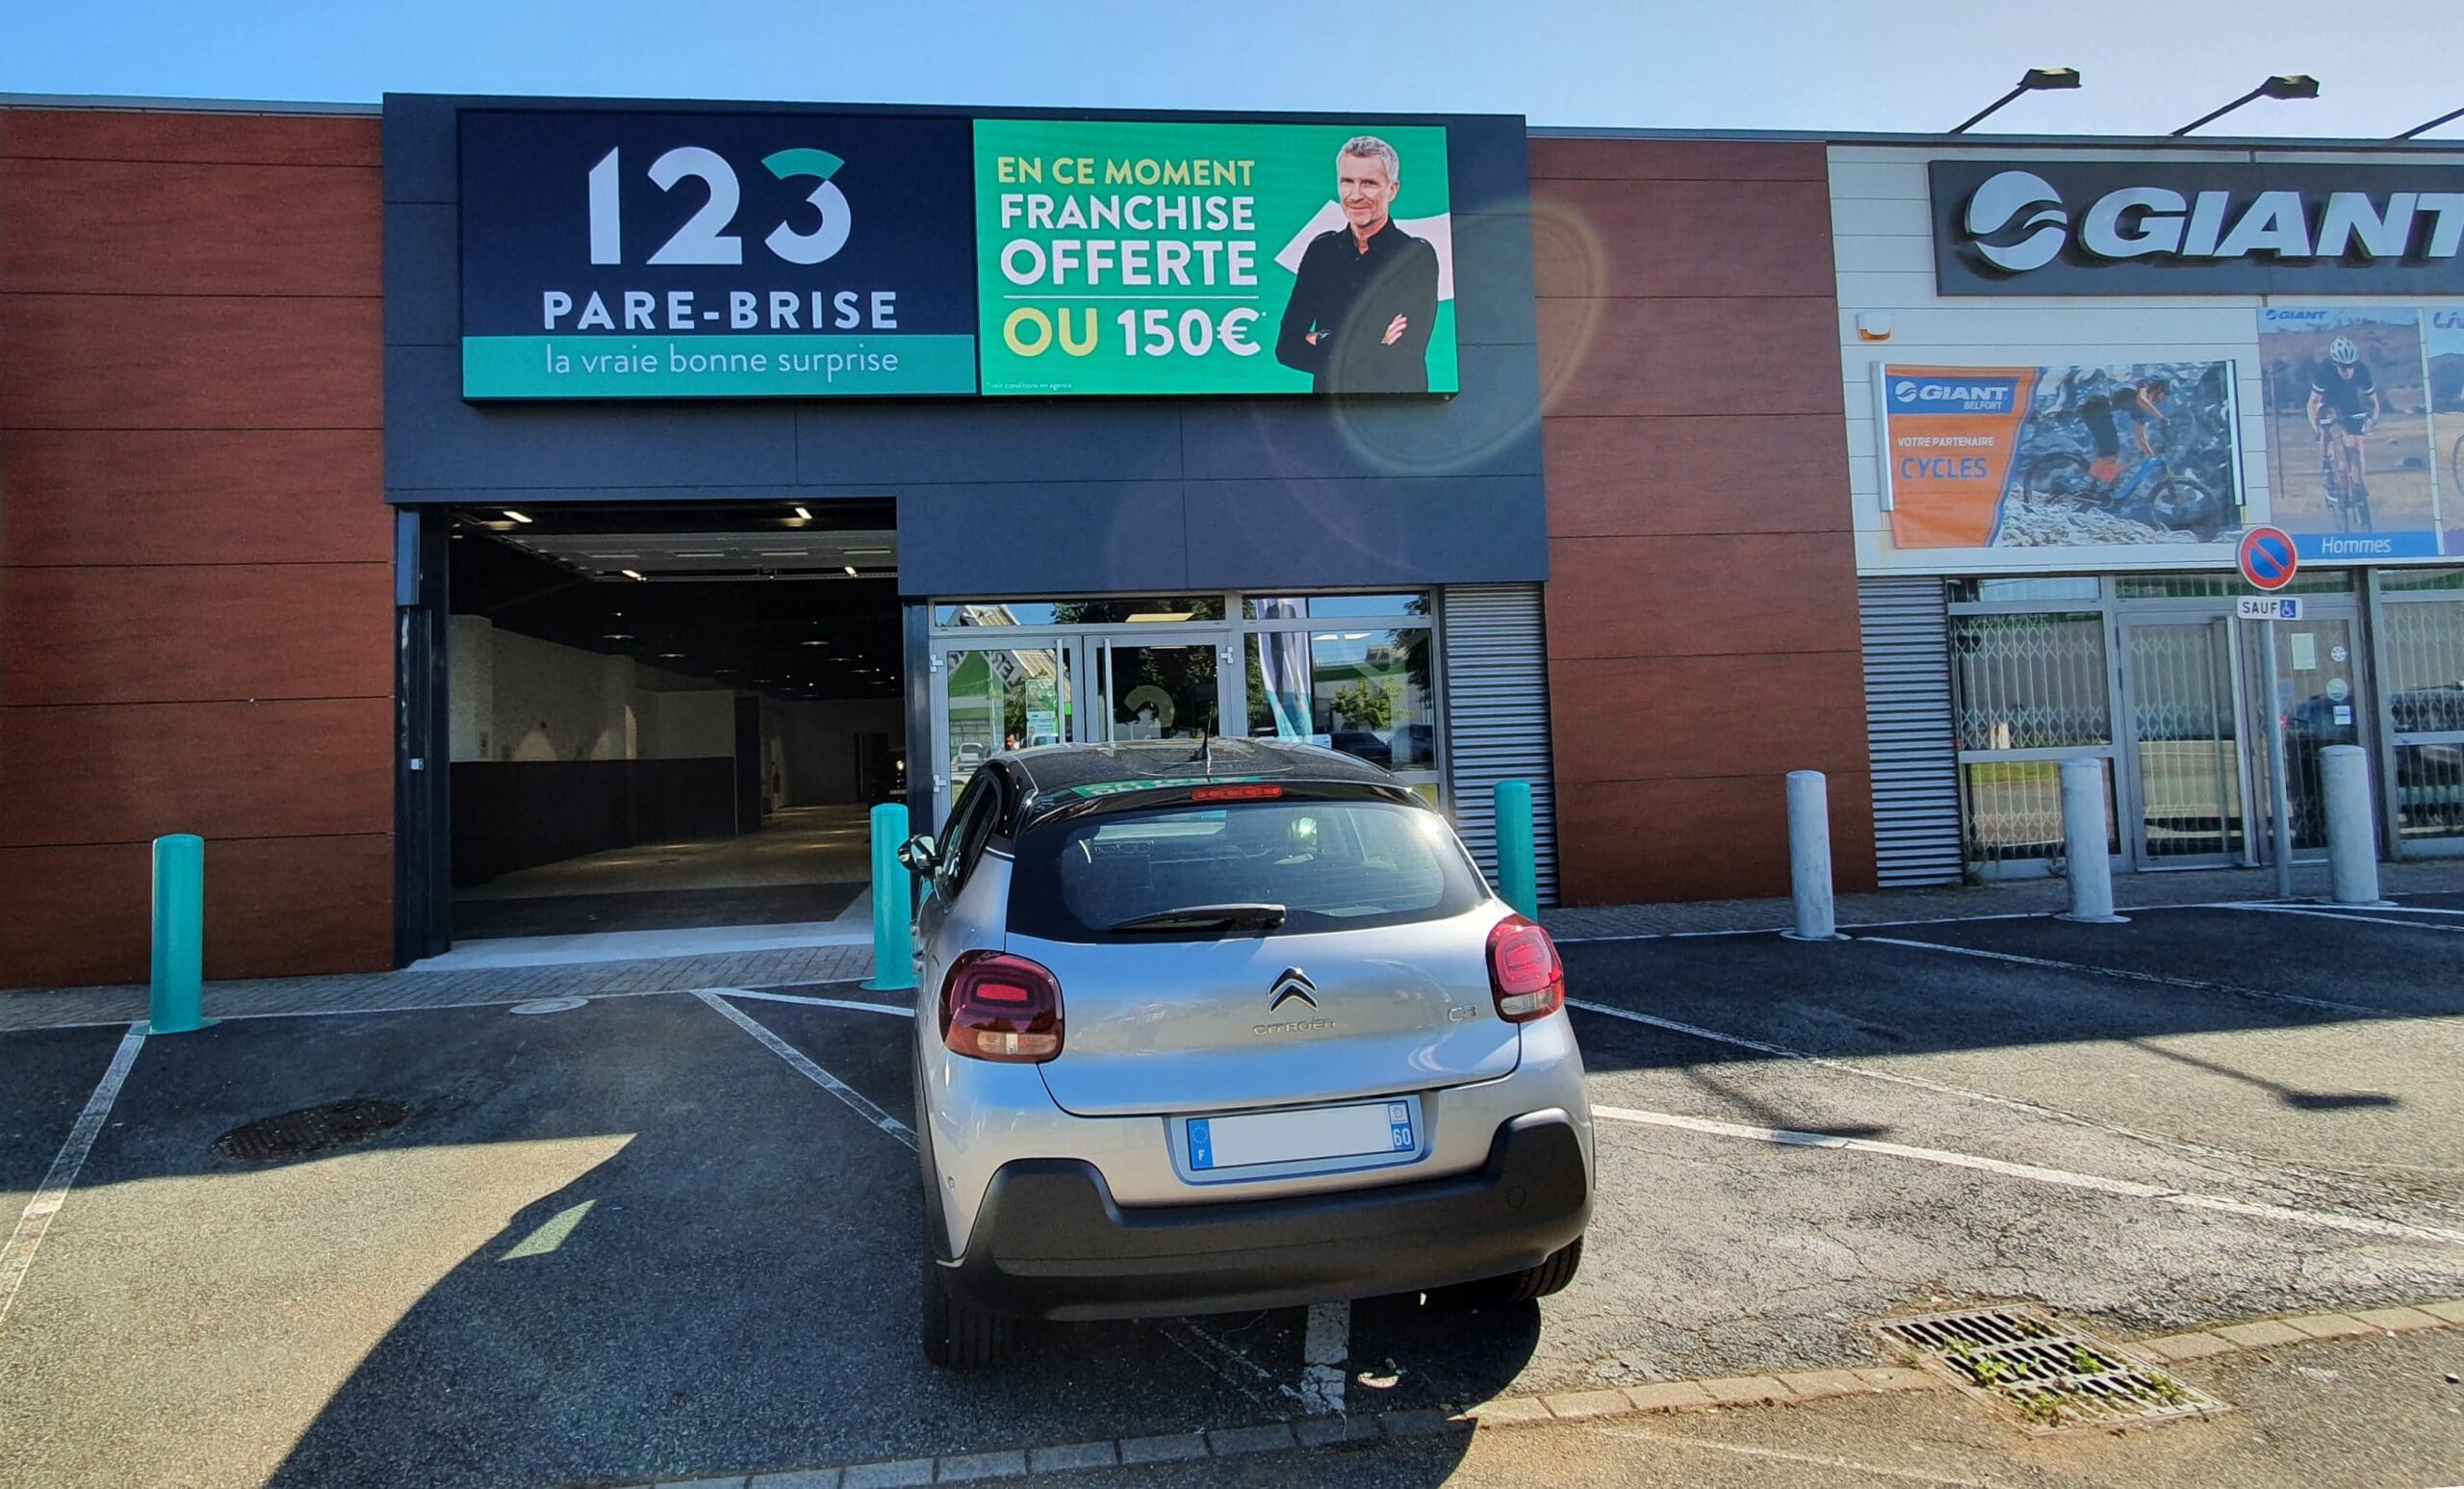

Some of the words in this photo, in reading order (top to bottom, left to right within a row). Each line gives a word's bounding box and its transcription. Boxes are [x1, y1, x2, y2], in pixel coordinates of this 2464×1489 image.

[997, 156, 1042, 183] EN
[1052, 158, 1095, 184] CE
[1104, 159, 1255, 187] MOMENT
[588, 145, 852, 266] 123
[1000, 193, 1255, 230] FRANCHISE
[2081, 186, 2464, 258] GIANT
[1000, 239, 1258, 286] OFFERTE
[544, 291, 898, 330] PARE-BRISE
[2278, 310, 2327, 321] GIANT
[1003, 307, 1098, 357] OU
[546, 344, 571, 373] la
[581, 344, 658, 374] vraie
[670, 345, 768, 372] bonne
[777, 344, 899, 383] surprise
[1919, 384, 2009, 400] GIANT
[1963, 400, 2003, 410] BELFORT
[1897, 436, 1931, 448] VOTRE
[1932, 436, 1995, 448] PARTENAIRE
[1900, 456, 1989, 479] CYCLES
[2322, 537, 2392, 554] Hommes
[2242, 601, 2278, 614] SAUF
[1393, 1127, 1412, 1146] 60
[1197, 1149, 1205, 1161] F
